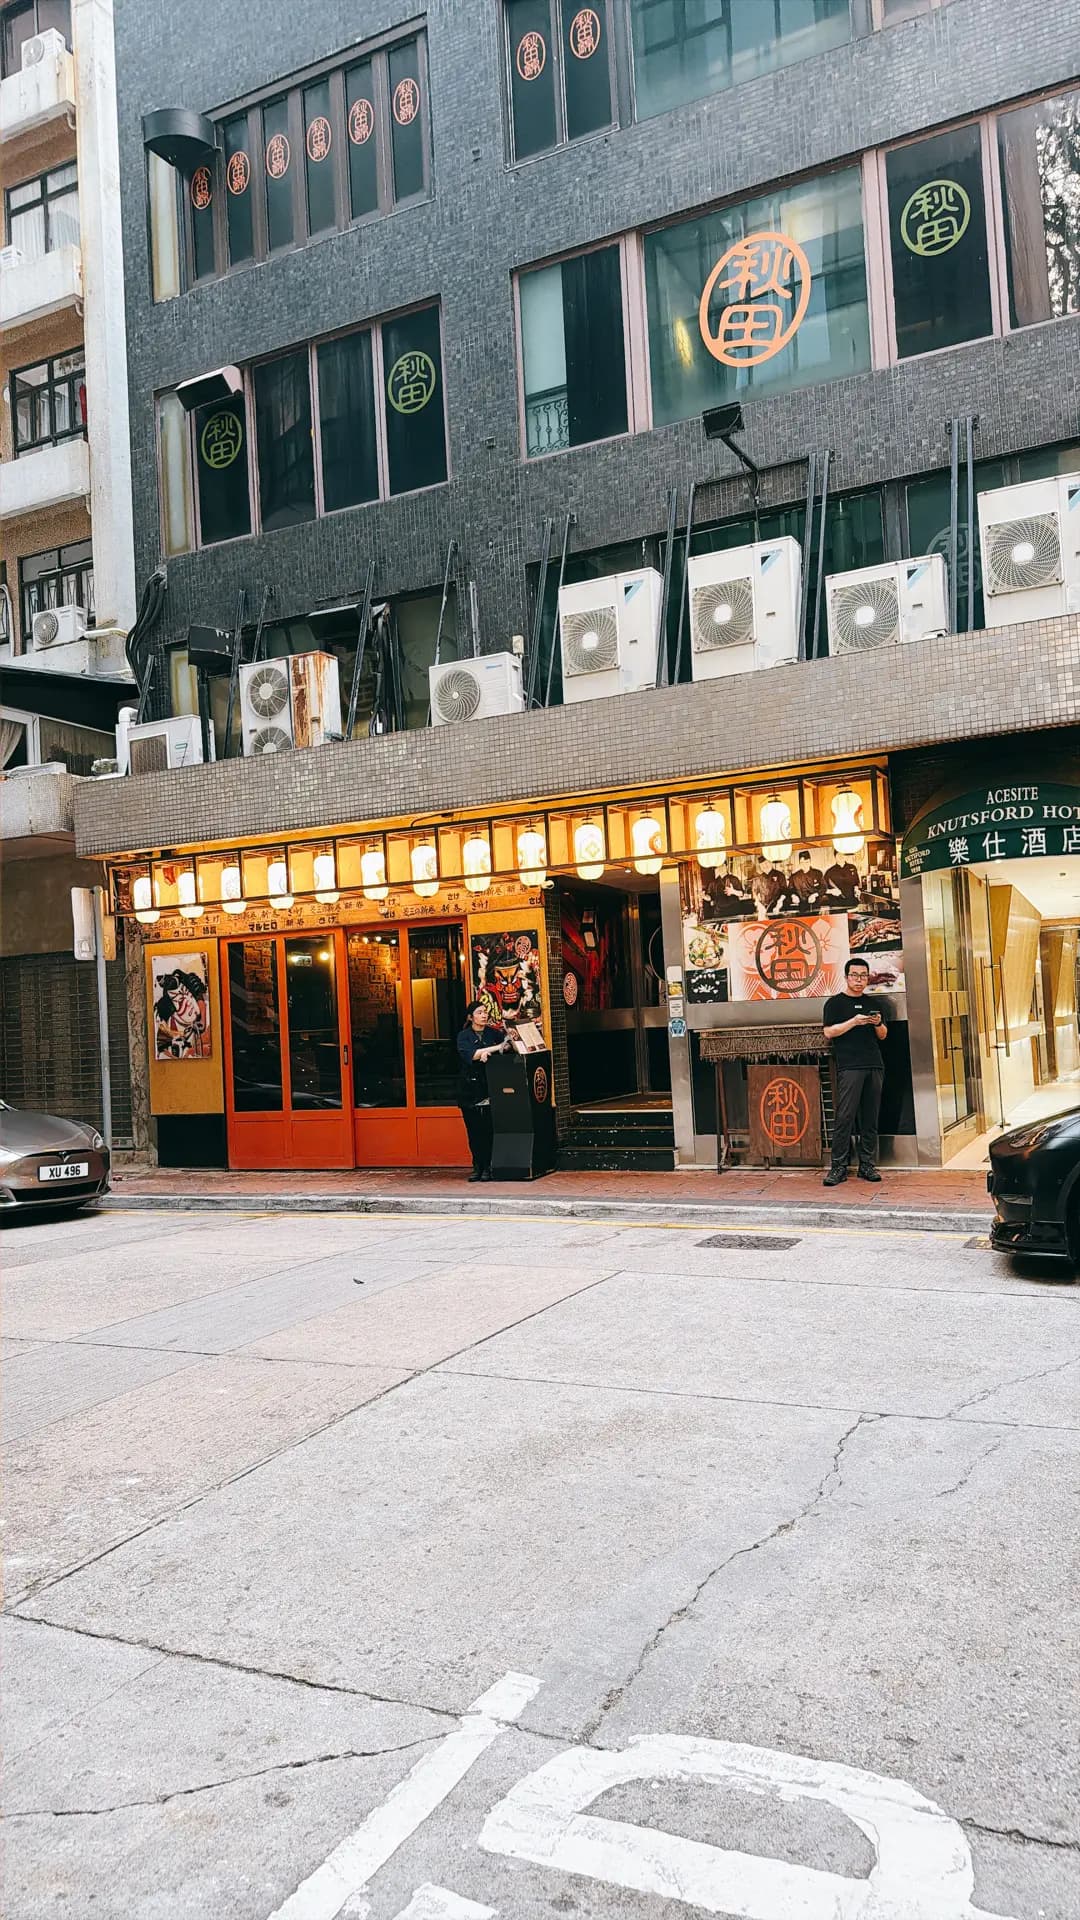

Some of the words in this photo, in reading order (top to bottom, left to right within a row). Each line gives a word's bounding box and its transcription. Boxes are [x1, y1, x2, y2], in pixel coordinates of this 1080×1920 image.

[986, 786, 1039, 805] ACESITE
[926, 805, 1034, 839] KNUTSFORD
[49, 1167, 62, 1179] XU
[64, 1165, 81, 1177] 496
